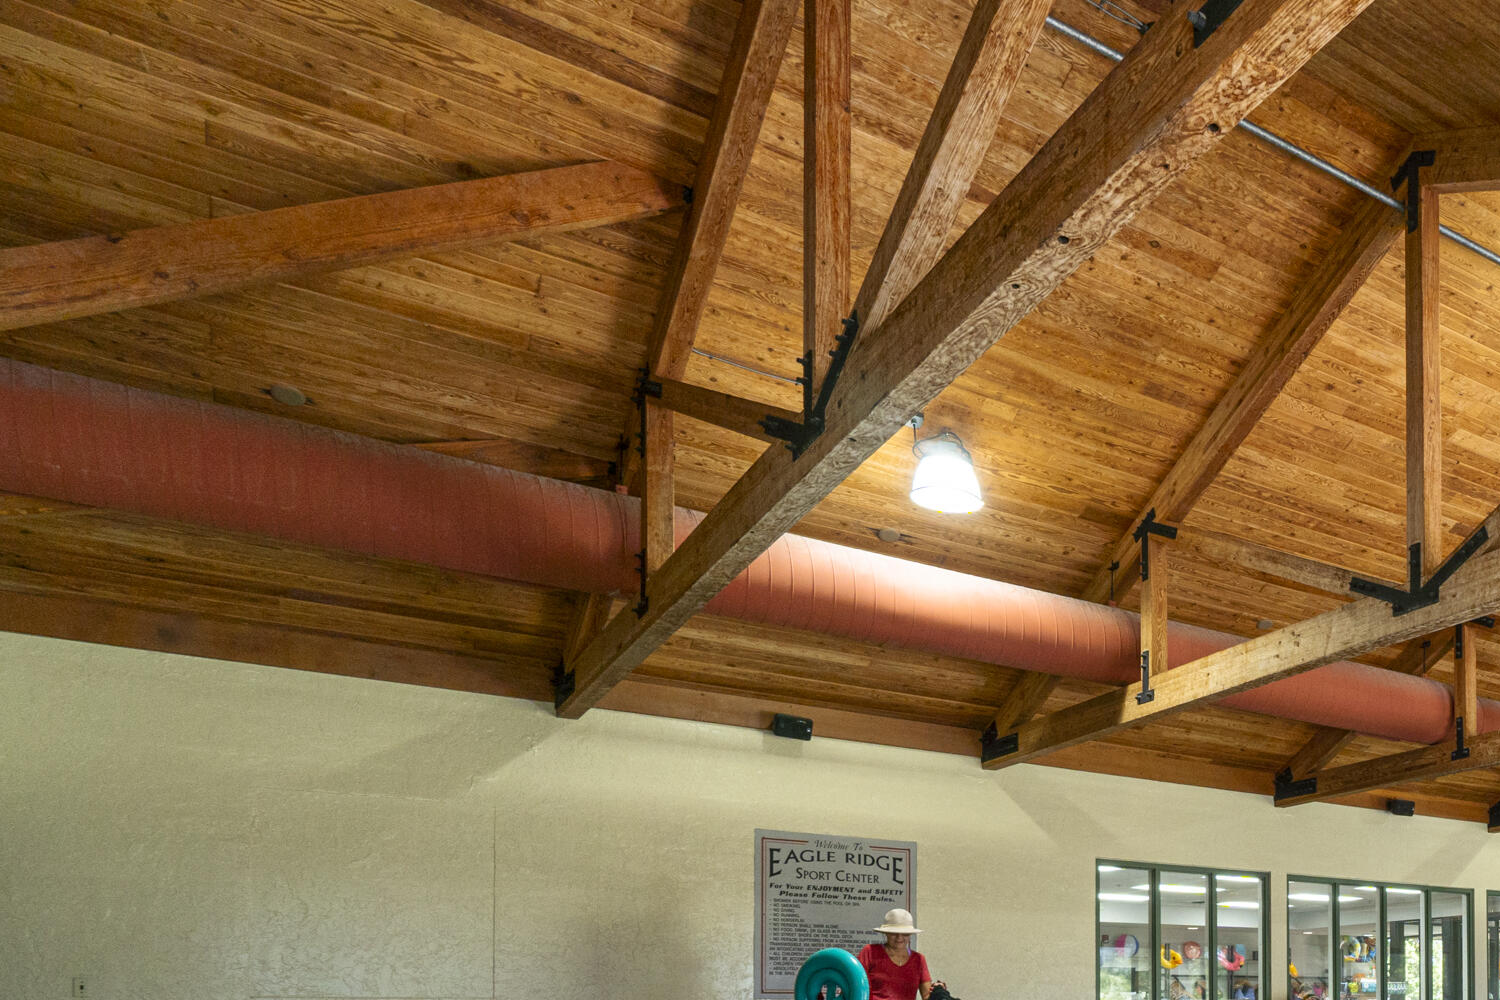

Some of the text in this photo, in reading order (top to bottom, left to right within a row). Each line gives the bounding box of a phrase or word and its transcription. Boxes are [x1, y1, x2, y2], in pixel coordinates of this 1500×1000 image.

[814, 839, 864, 851] Welcome To
[769, 848, 904, 885] EAGLE RIDGE
[796, 867, 880, 884] SPORT CENTER
[806, 884, 855, 894] ENJOYMENT
[779, 890, 808, 898] Please
[811, 892, 840, 900] Follow
[843, 893, 867, 901] These
